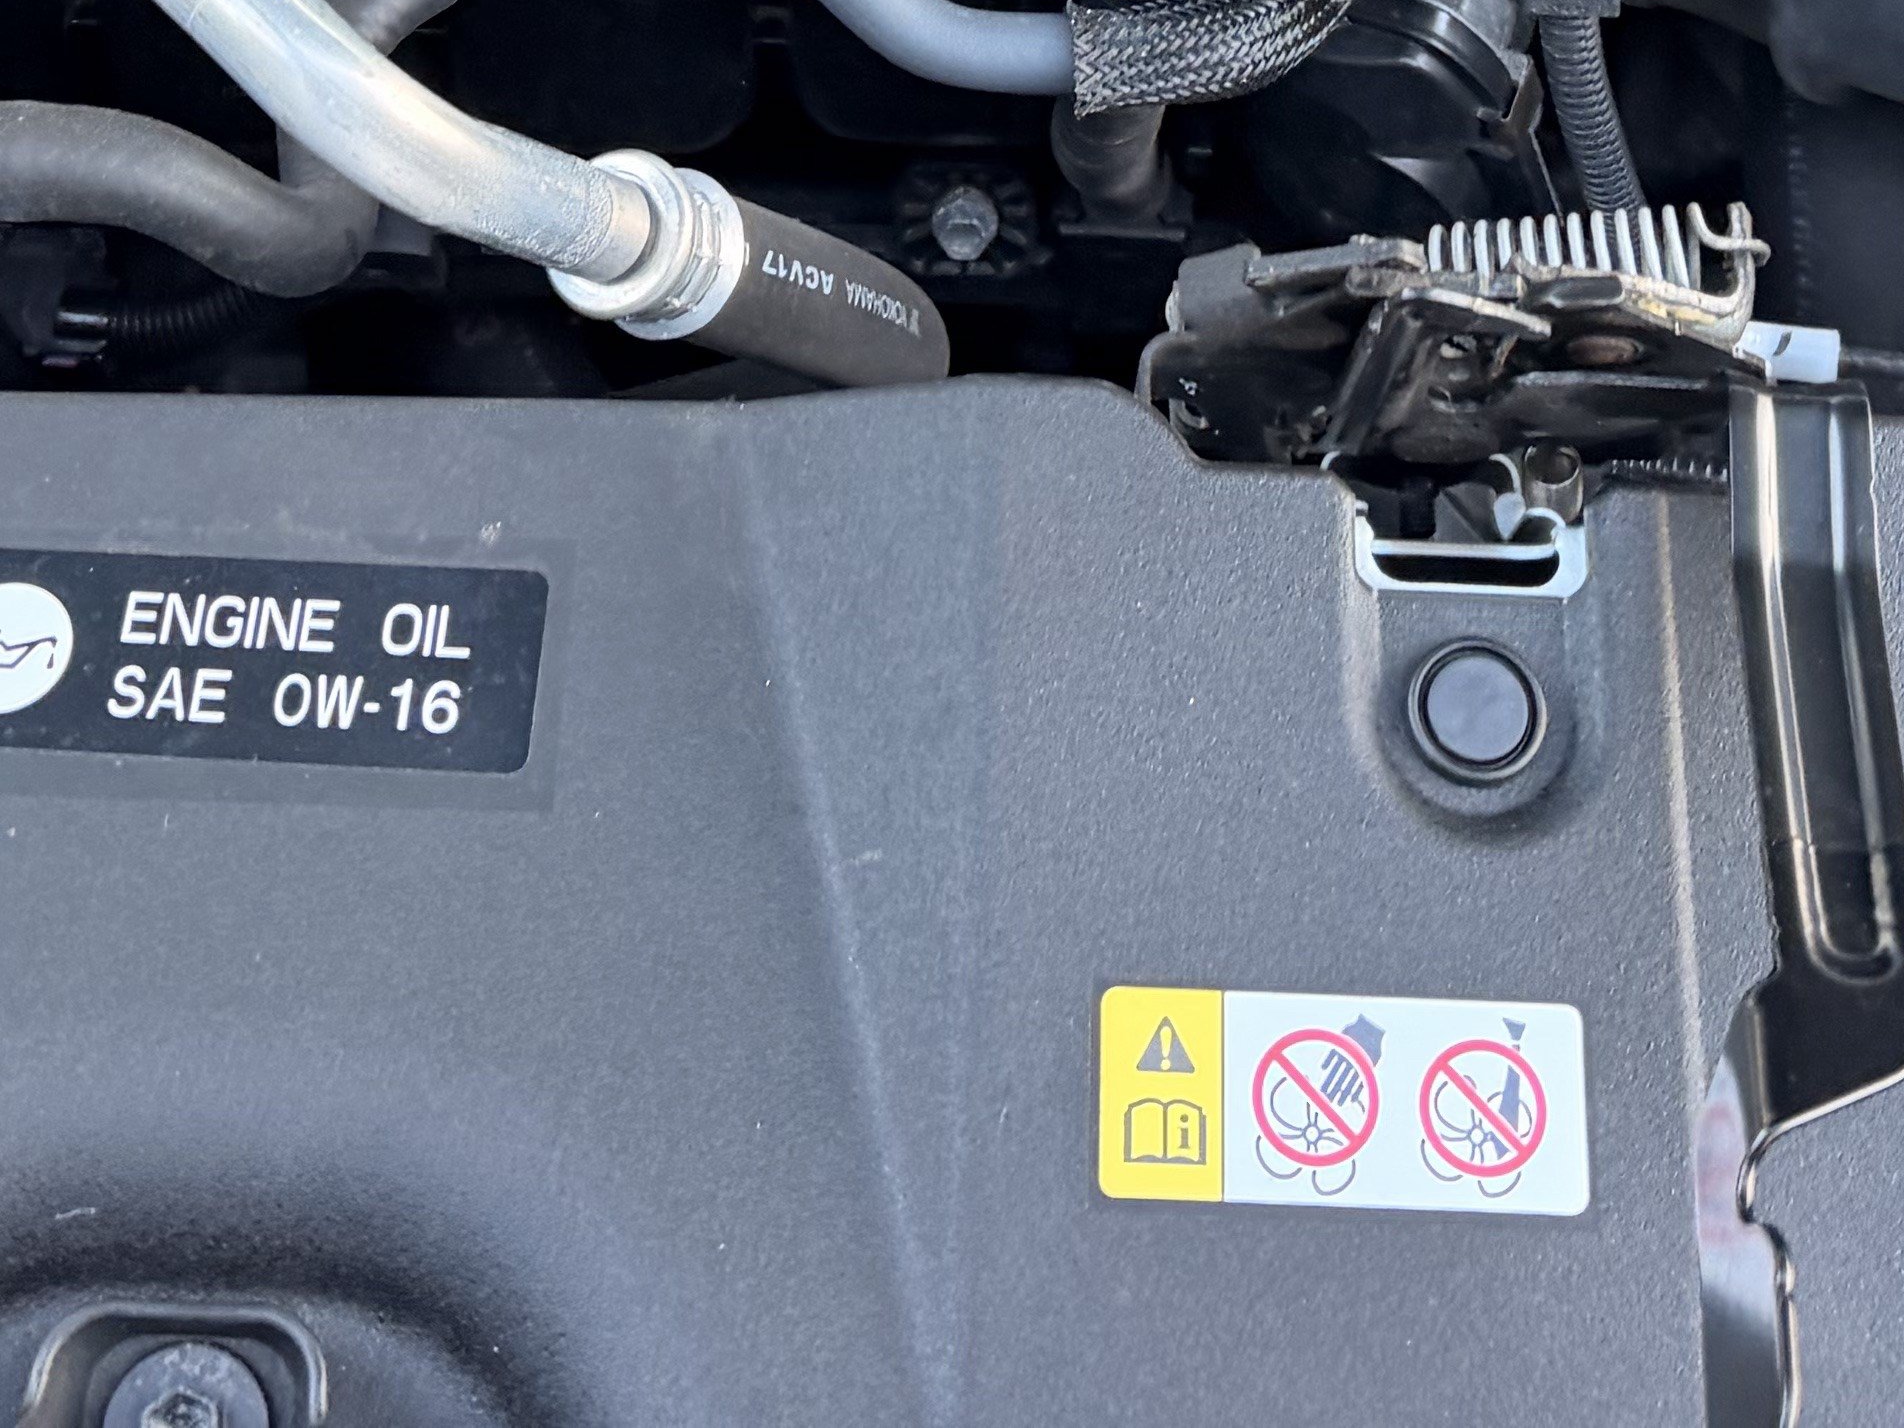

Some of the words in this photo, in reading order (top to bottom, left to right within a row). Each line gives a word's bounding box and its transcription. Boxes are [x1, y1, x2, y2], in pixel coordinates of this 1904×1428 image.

[761, 250, 835, 295] ACV17
[120, 591, 341, 653] ENGINE
[382, 603, 470, 659] OIL
[107, 665, 232, 724] SAE
[274, 673, 460, 734] 0W-16
